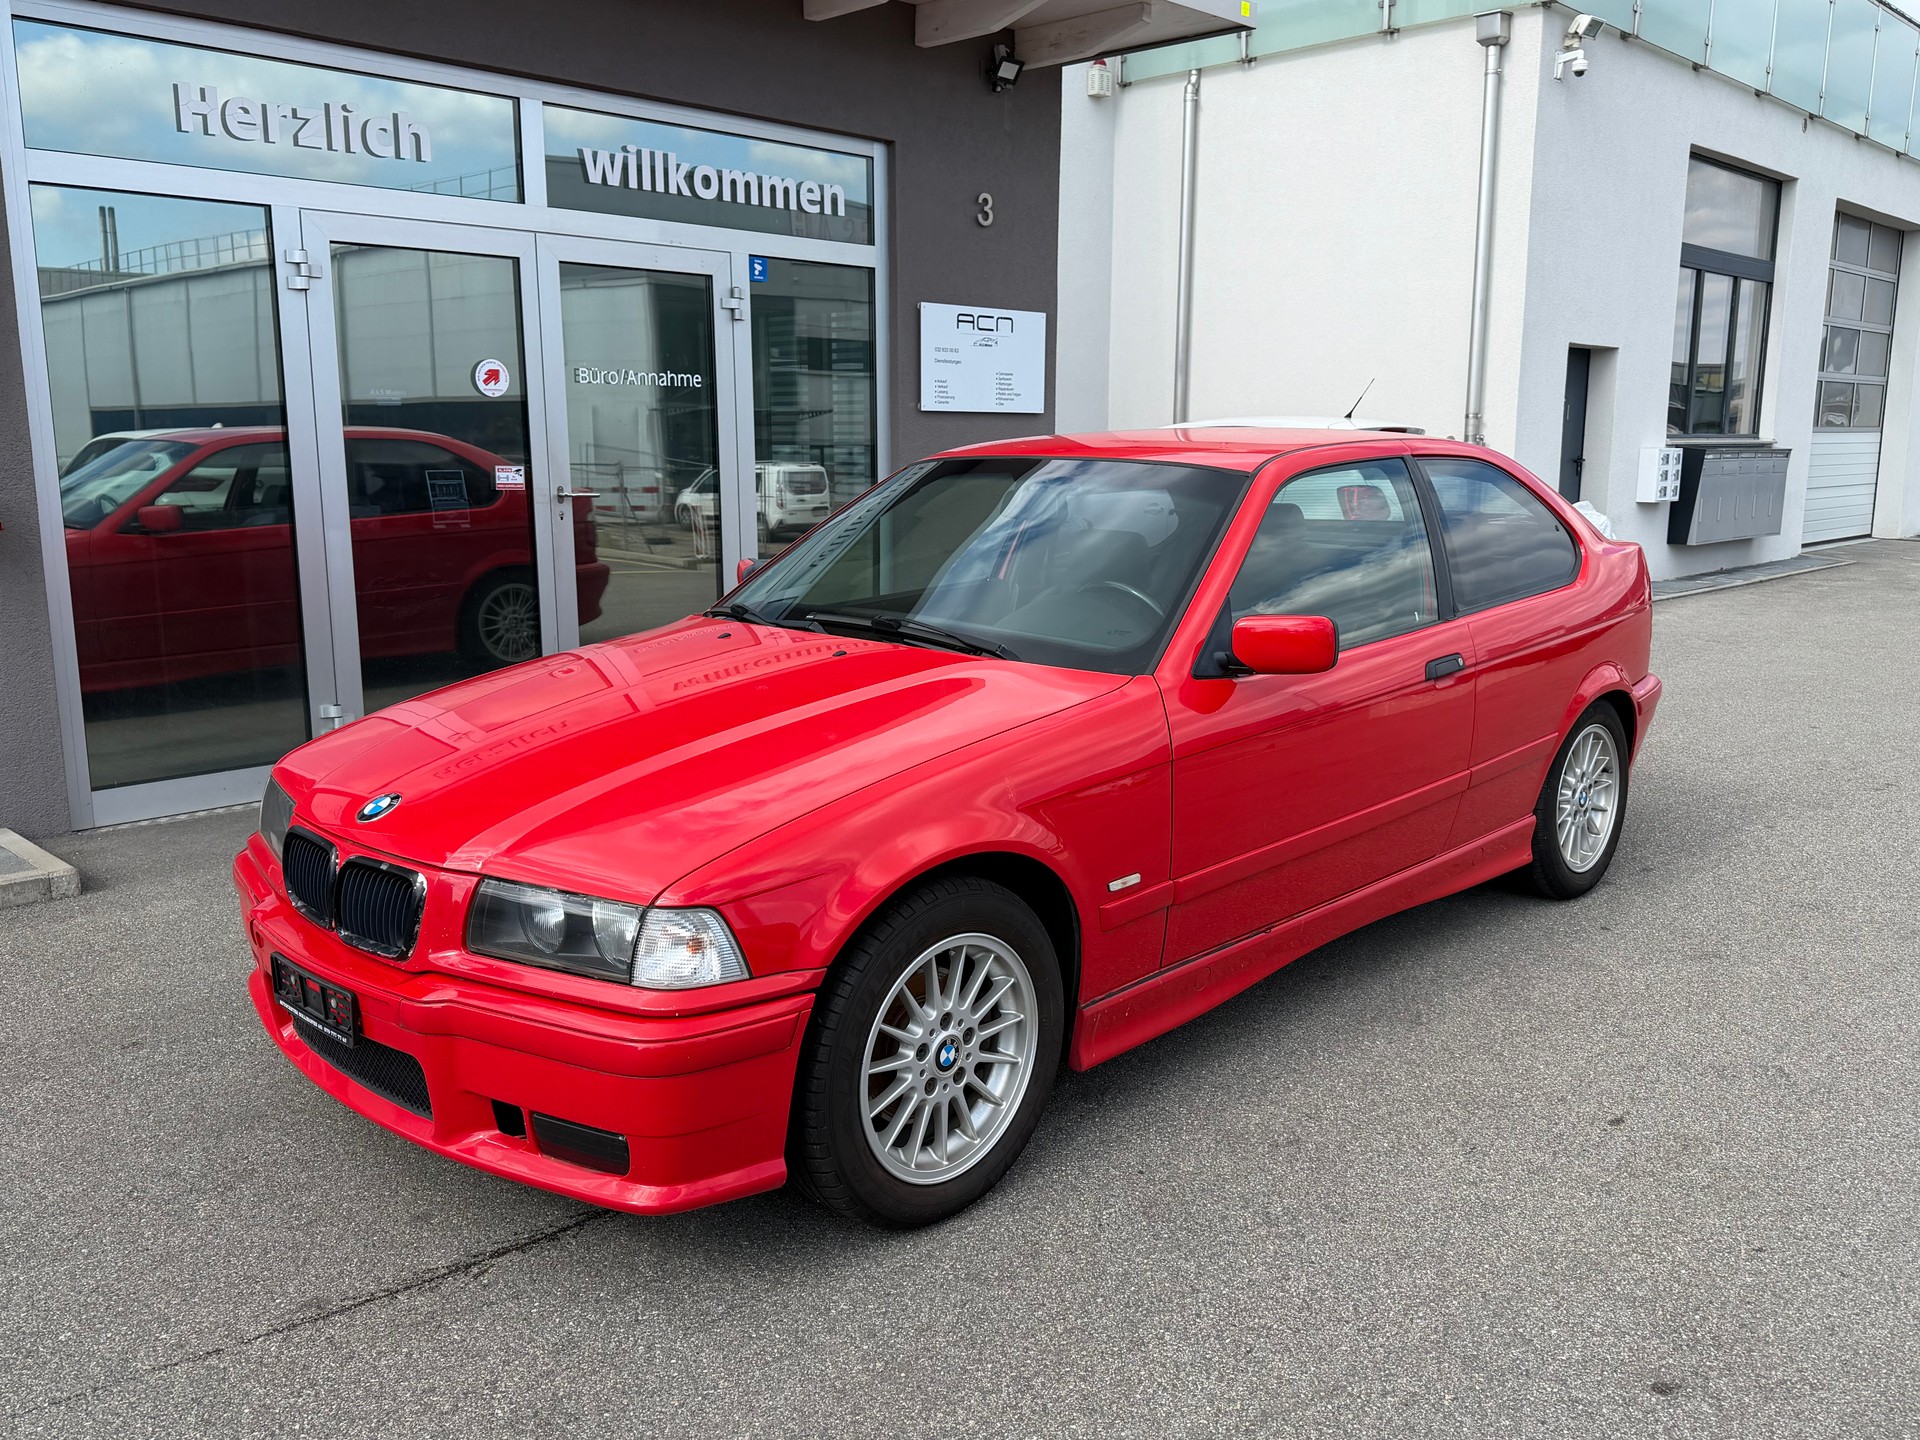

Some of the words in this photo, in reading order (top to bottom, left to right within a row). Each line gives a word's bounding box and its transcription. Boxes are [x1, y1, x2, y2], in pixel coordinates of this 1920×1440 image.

[173, 81, 432, 162] Herzlich
[579, 144, 846, 217] willkommen
[977, 192, 994, 226] 3
[956, 312, 1014, 334] ACN
[579, 368, 702, 388] Büro/Annahme
[946, 1039, 959, 1059] BMW
